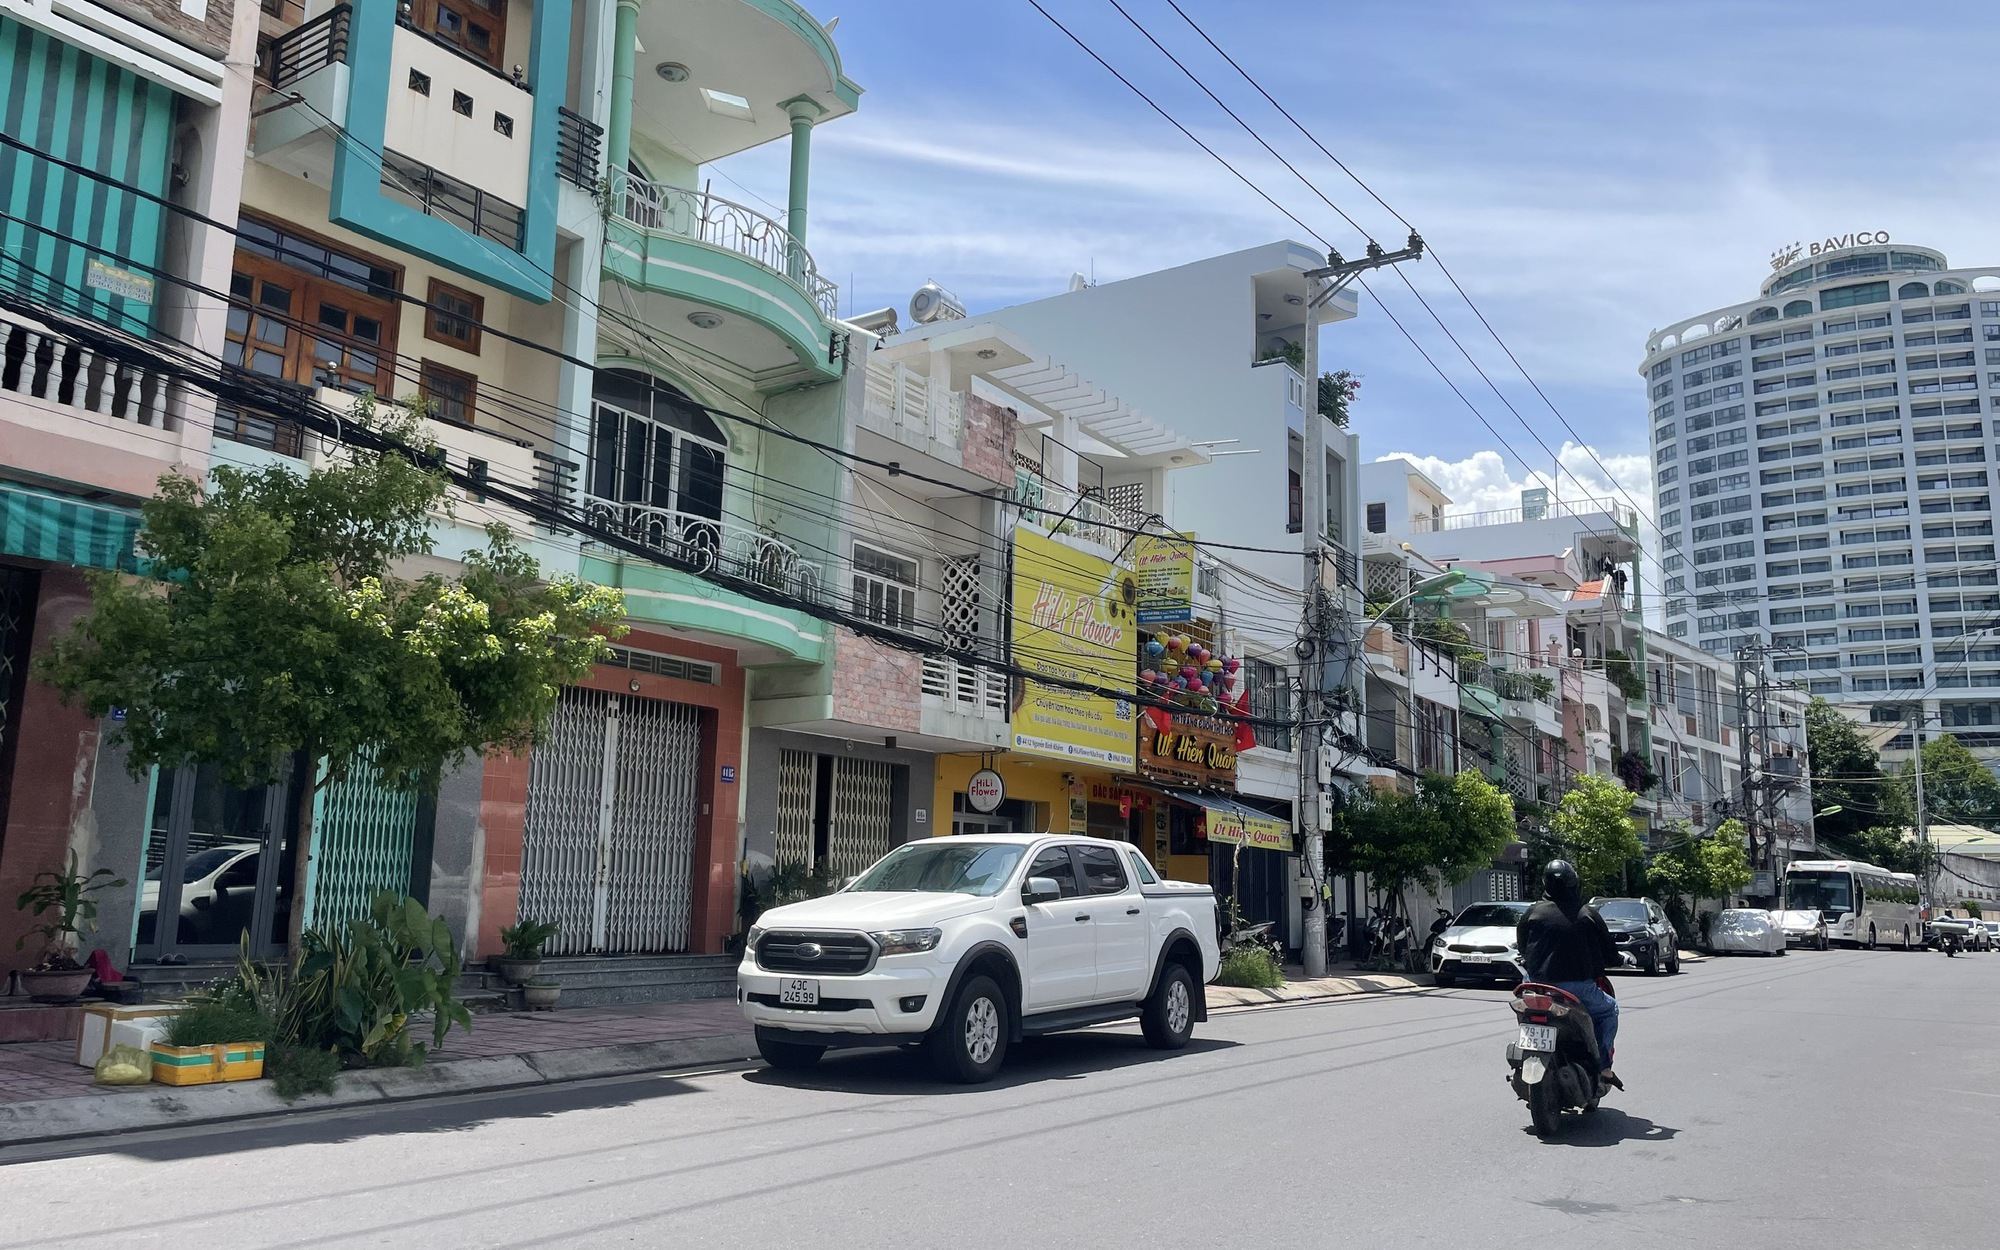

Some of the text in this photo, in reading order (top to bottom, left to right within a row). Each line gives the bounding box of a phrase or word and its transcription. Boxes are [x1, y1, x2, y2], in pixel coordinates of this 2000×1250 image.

[1810, 231, 1890, 256] BAVICO
[1070, 597, 1121, 647] Flower
[1177, 735, 1204, 763] Hiền
[1209, 743, 1236, 770] Quán
[976, 779, 993, 787] HiLi
[971, 784, 998, 796] Flower
[1213, 820, 1226, 835] Út
[1254, 829, 1280, 844] Quán
[791, 980, 808, 991] 43C
[784, 991, 814, 1003] 245.99
[1525, 1026, 1550, 1038] 79-V1
